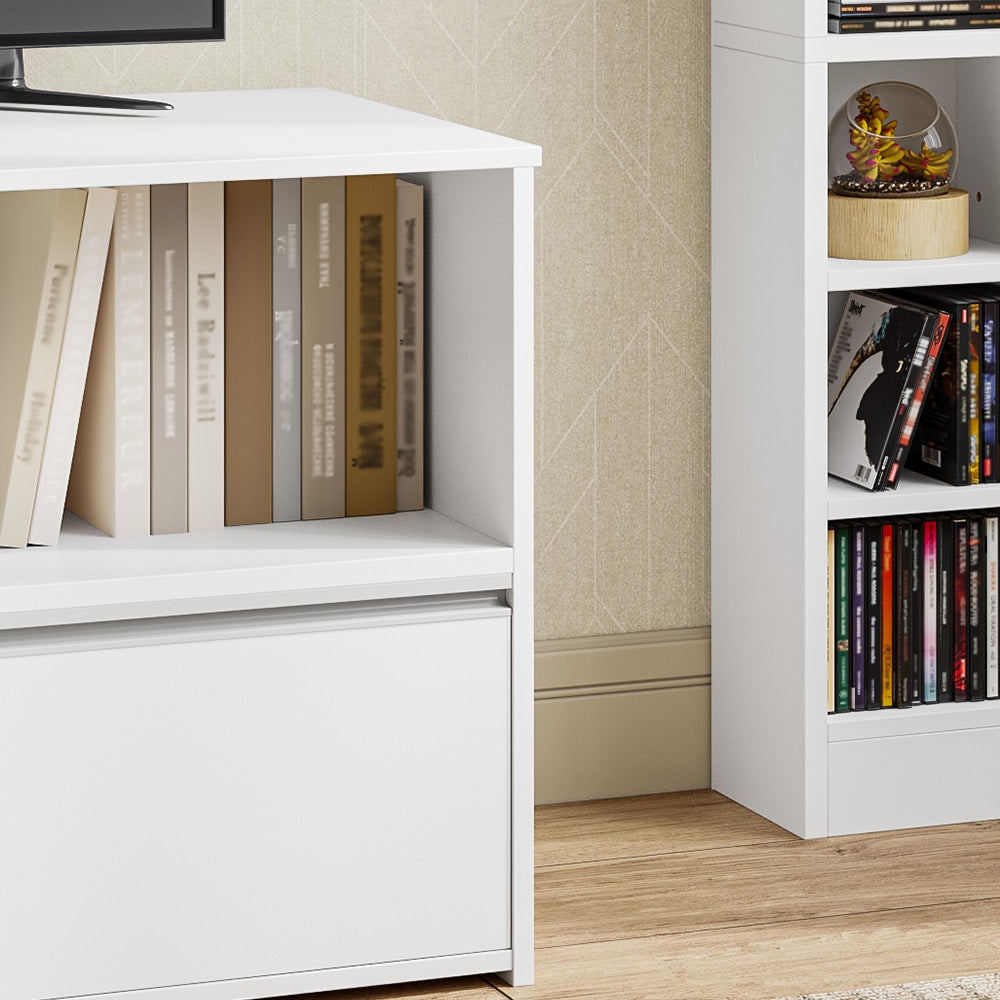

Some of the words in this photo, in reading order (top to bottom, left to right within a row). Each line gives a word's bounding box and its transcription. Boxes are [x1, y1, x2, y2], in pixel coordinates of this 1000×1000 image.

[196, 272, 216, 310] Lee
[196, 319, 216, 424] Radziwill
[17, 391, 47, 467] Holiday
